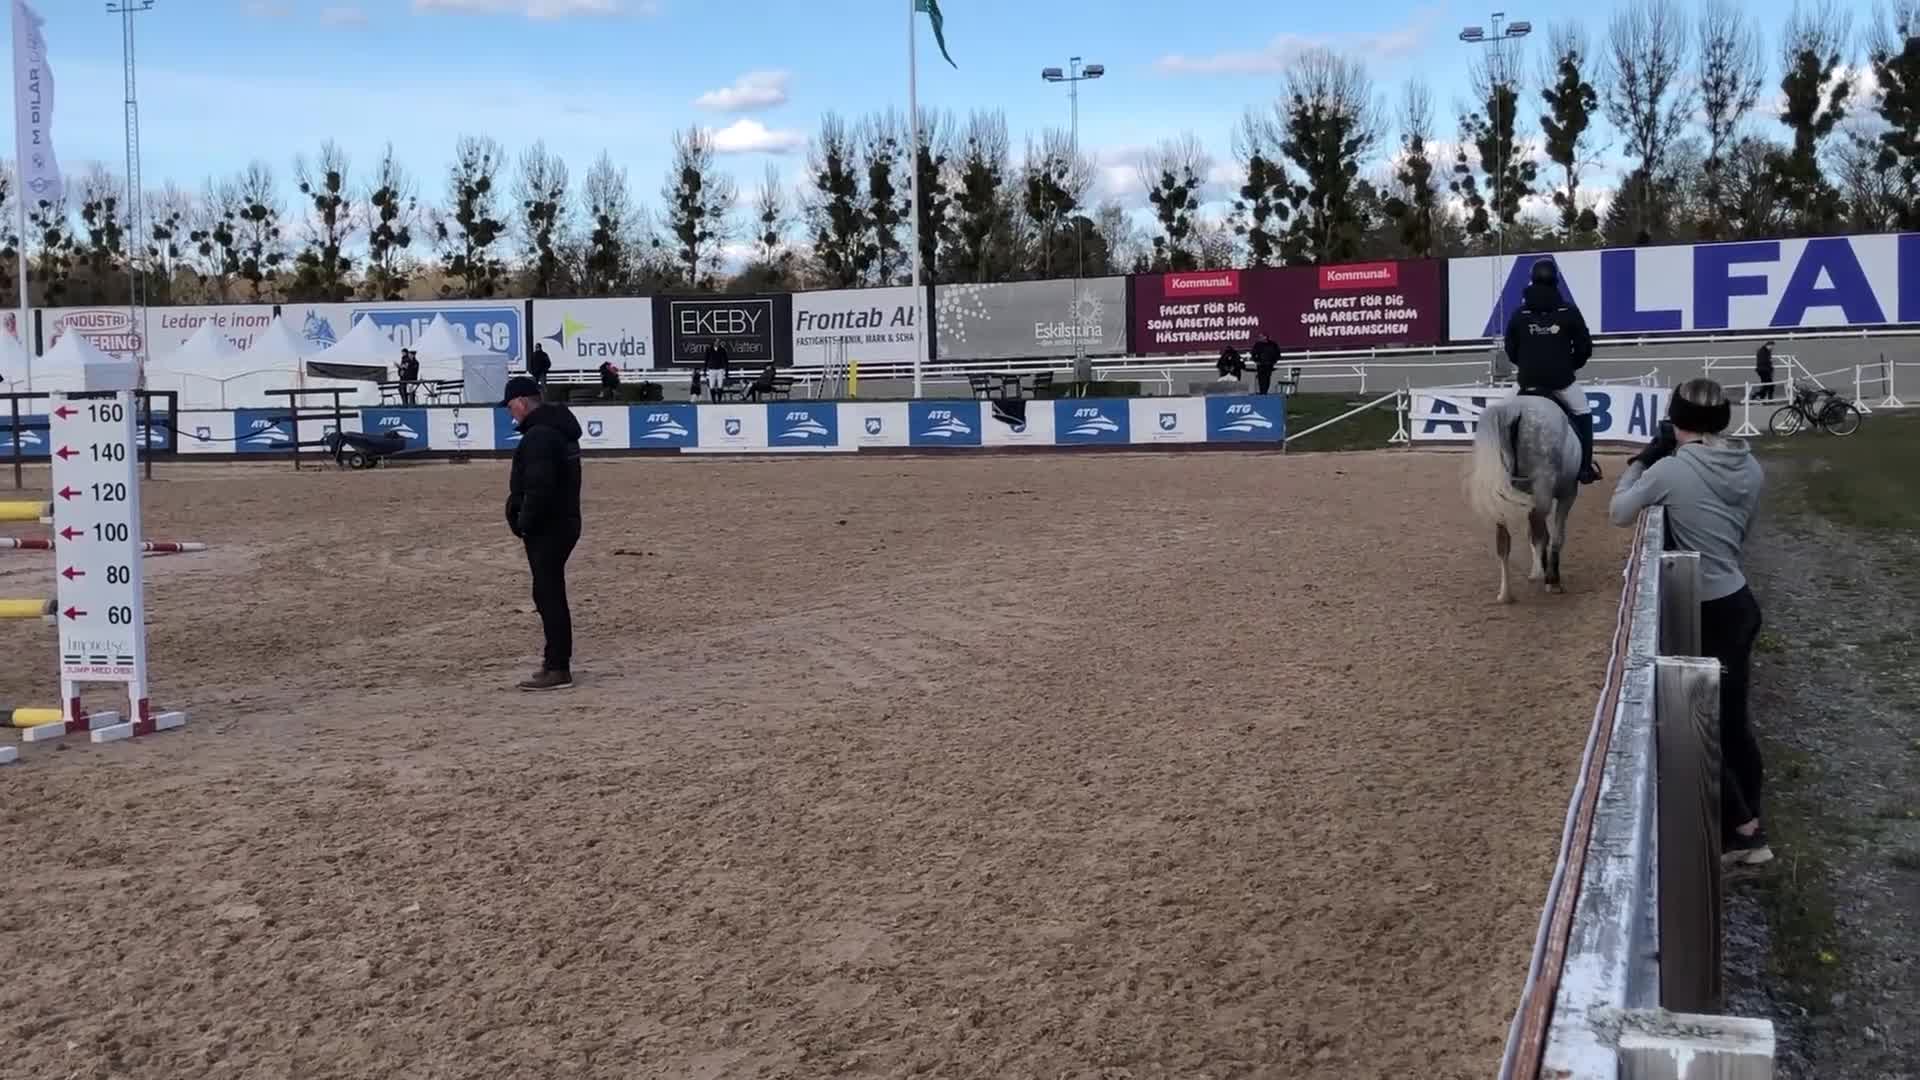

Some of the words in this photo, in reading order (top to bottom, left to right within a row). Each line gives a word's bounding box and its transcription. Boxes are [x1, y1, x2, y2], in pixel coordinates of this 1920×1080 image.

[1482, 233, 1920, 338] ALFA
[1160, 304, 1201, 317] FACKET
[1204, 302, 1225, 314] FÖR
[1313, 297, 1357, 310] FACKET
[1360, 295, 1382, 307] FÖR
[64, 314, 125, 328] INDUSTRI
[231, 312, 270, 328] inom
[681, 308, 763, 335] EKEBY
[796, 307, 883, 331] Frontab
[1147, 320, 1174, 330] SOM
[1175, 317, 1224, 328] ARBETAR
[1300, 313, 1328, 324] SOM
[1330, 310, 1382, 322] ARBETAR
[1156, 330, 1250, 343] HÄSTBRANSCHEN
[1309, 324, 1409, 337] HÄSTBRANSCHEN
[577, 336, 646, 357] bravida
[88, 403, 123, 423] 160
[785, 411, 809, 421] ATG
[927, 410, 952, 420] ATG
[1074, 407, 1099, 418] ATG
[1226, 404, 1252, 414] ATG
[379, 416, 401, 426] ATG
[646, 412, 670, 423] ATG
[89, 443, 125, 462] 140
[91, 482, 127, 501] 120
[93, 522, 129, 542] 100
[106, 565, 130, 584] 80
[108, 606, 132, 625] 60
